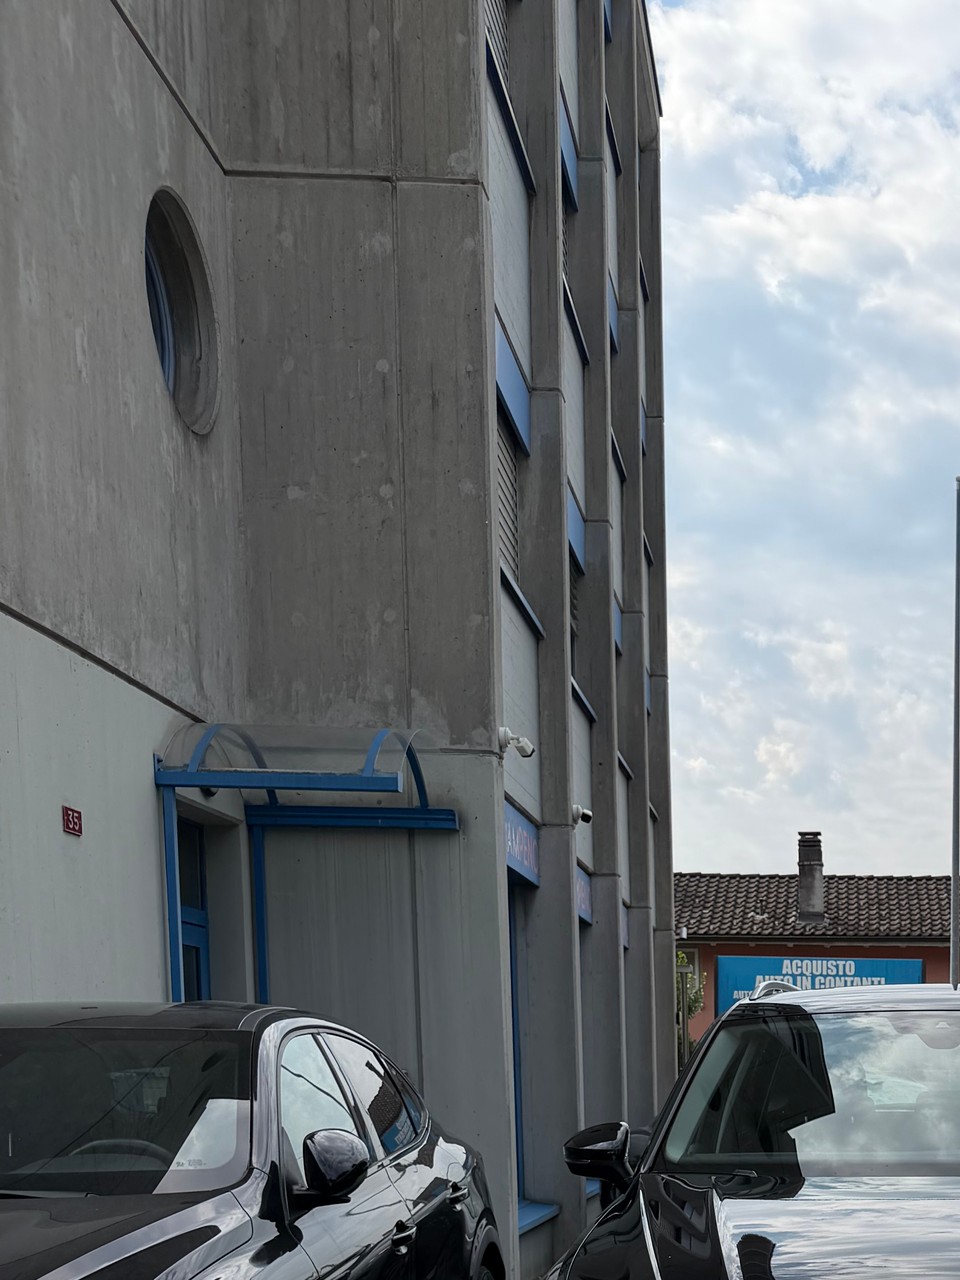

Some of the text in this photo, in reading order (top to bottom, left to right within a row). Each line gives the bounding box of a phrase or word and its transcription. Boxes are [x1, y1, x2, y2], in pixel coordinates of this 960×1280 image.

[68, 810, 79, 830] 35
[782, 959, 855, 976] ACQUISTO
[796, 975, 812, 990] IN
[733, 990, 752, 999] AUT
